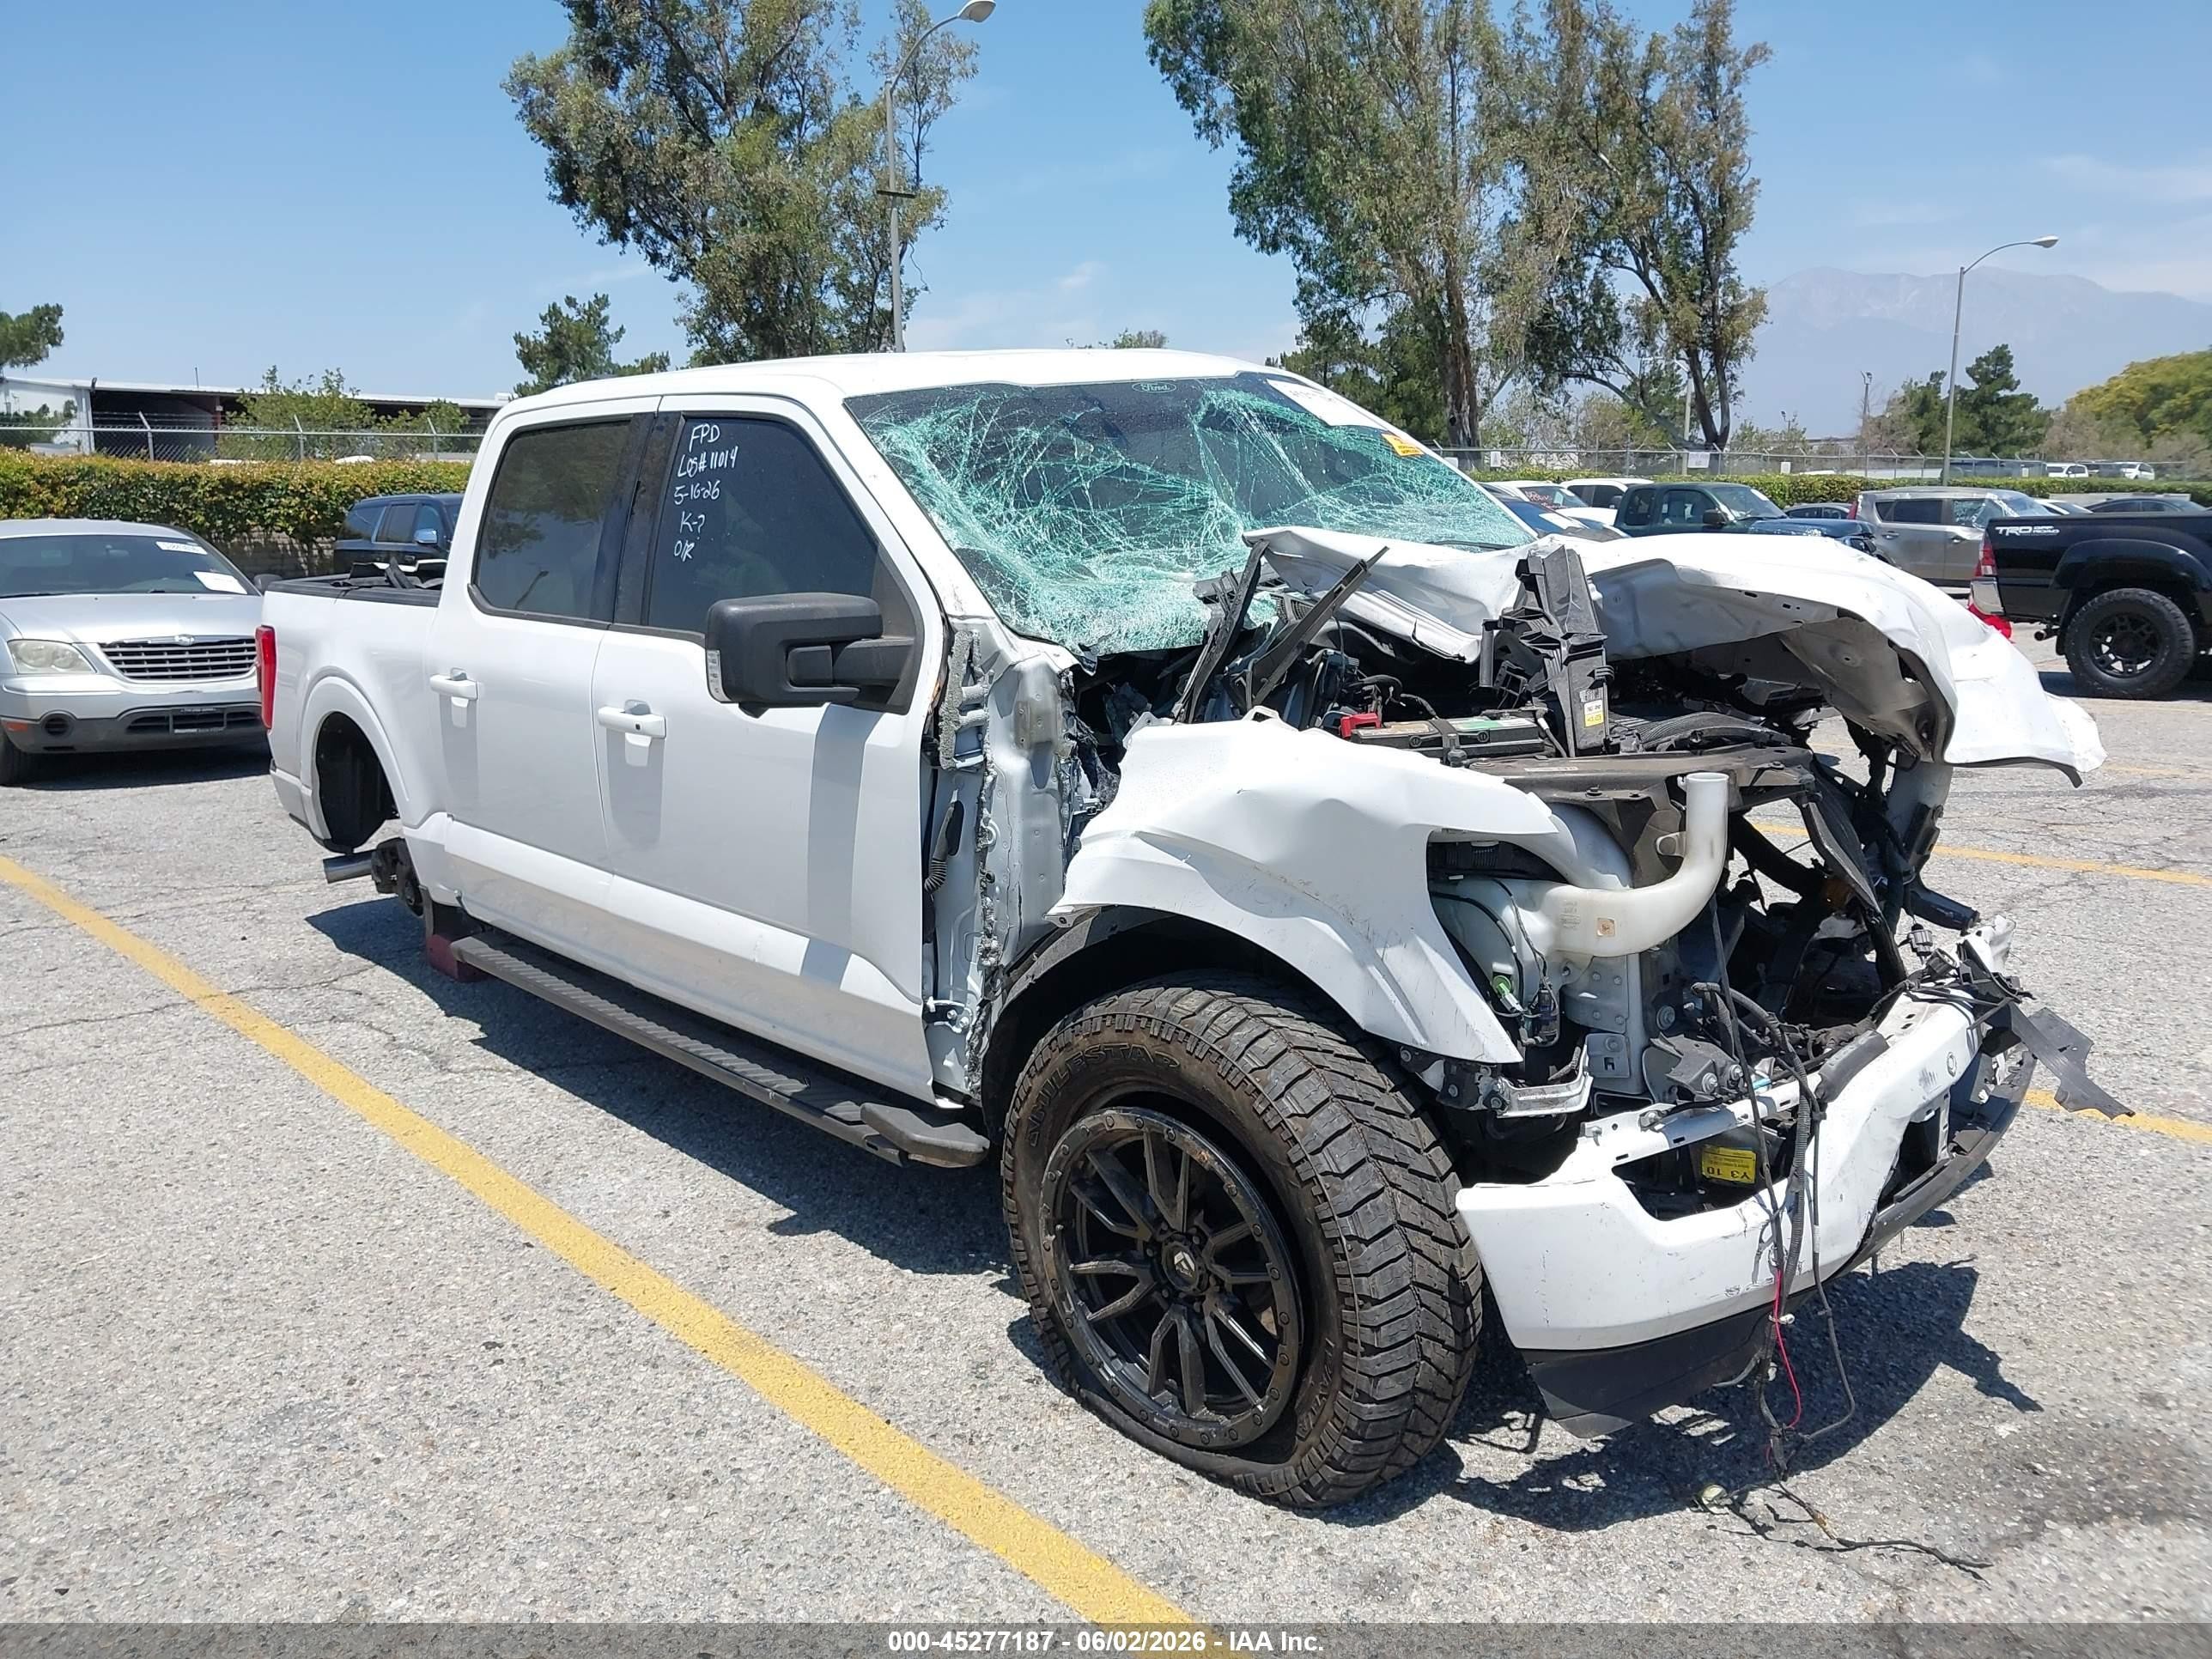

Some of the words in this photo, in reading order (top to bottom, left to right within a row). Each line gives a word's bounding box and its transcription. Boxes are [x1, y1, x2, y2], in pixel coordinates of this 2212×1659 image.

[1140, 383, 1170, 392] Ford
[689, 423, 720, 453] FPD
[709, 446, 738, 469] 11014
[674, 480, 720, 505] 5-16-26
[1995, 526, 2033, 536] TRD
